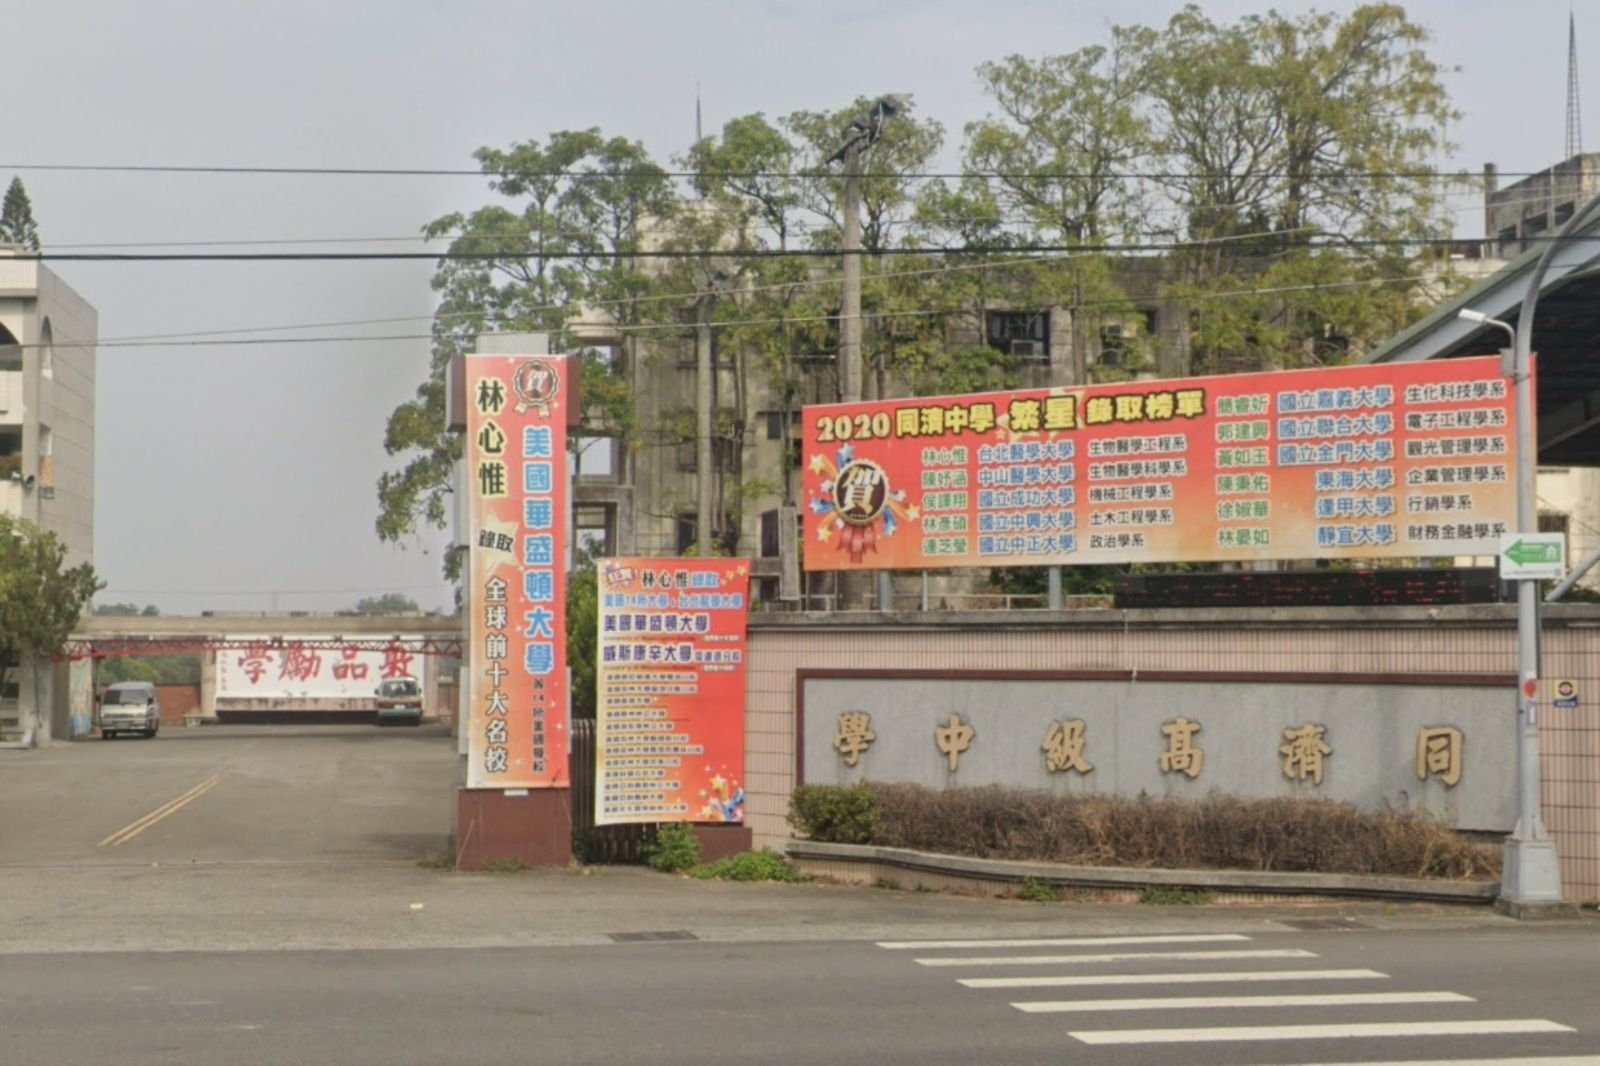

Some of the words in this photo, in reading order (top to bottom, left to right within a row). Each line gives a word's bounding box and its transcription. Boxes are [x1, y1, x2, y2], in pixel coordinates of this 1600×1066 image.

[1407, 381, 1505, 402] 生化科技學系
[816, 411, 891, 442] 2020
[1009, 395, 1077, 431] 繁星
[1278, 412, 1392, 437] 國立聯合大學
[1407, 409, 1505, 428] 電子工程學系
[478, 379, 504, 495] 林心惟
[923, 448, 966, 465] 林心惟
[979, 441, 1073, 462] 台北醫學大學
[1089, 435, 1185, 455] 生物醫學工程系
[1278, 440, 1392, 463] 國立金門大學
[1407, 437, 1505, 456] 觀光管理學系
[979, 464, 1073, 486] 中山醫學大學
[1089, 459, 1185, 479] 生物醫學科學系
[1318, 467, 1392, 489] 東海大學
[1407, 465, 1505, 484] 企業管理學系
[841, 466, 880, 514] 賀
[979, 487, 1073, 509] 國立成功大學
[1089, 484, 1172, 502] 機械工程學系
[1318, 495, 1392, 517] 逢甲大學
[1407, 494, 1472, 512] 行銷學系
[979, 511, 1073, 532] 國立中興大學
[1089, 508, 1172, 526] 土木工程學系
[479, 529, 514, 553] 錄取
[979, 534, 1074, 554] 國立中正大學
[1089, 532, 1144, 549] 政治學系
[1318, 523, 1393, 546] 靜宜大學
[1408, 521, 1506, 541] 財務金融學系
[525, 427, 553, 672] 美國華盛頓大學
[484, 575, 508, 773] 全球前十大名校
